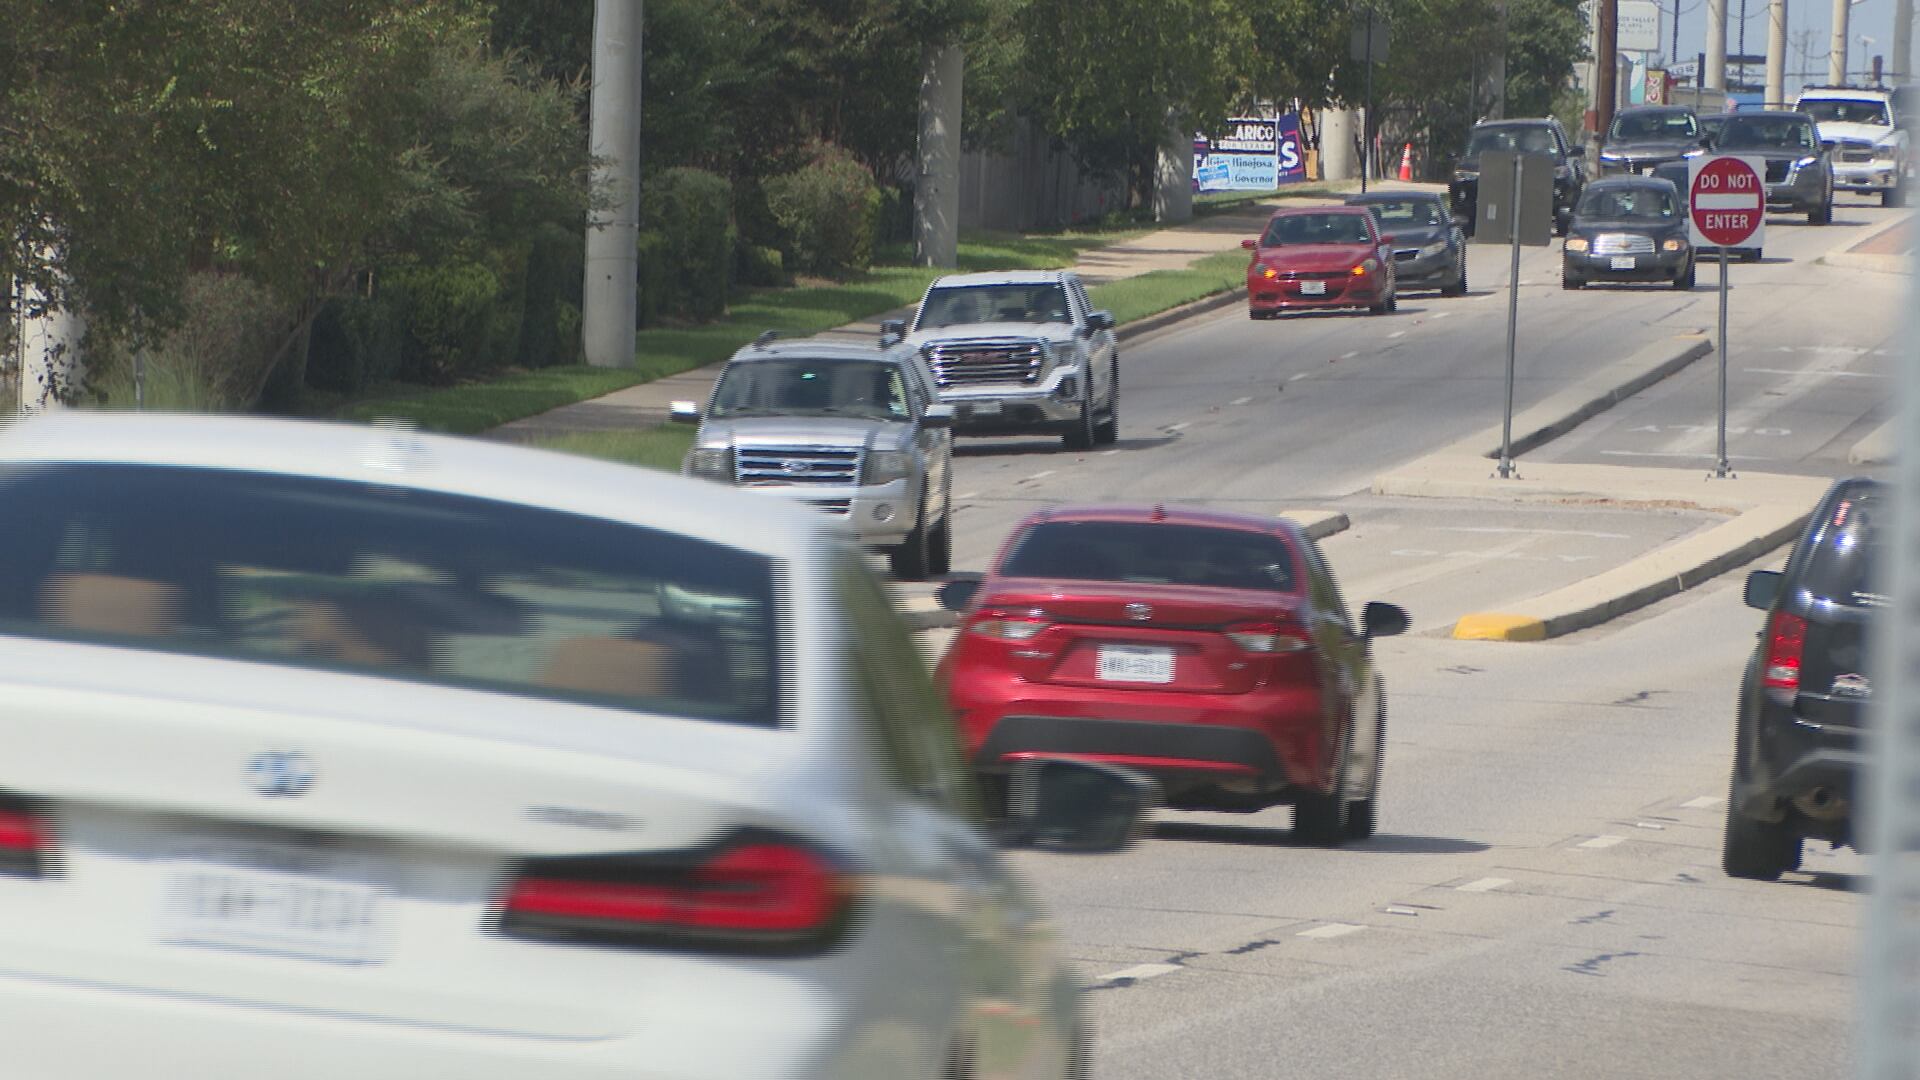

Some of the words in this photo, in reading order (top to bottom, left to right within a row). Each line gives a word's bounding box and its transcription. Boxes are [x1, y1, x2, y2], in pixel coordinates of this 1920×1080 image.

[1235, 175, 1273, 183] Governor
[1701, 174, 1719, 188] DO
[1728, 174, 1754, 188] NOT
[1706, 214, 1748, 229] ENTER
